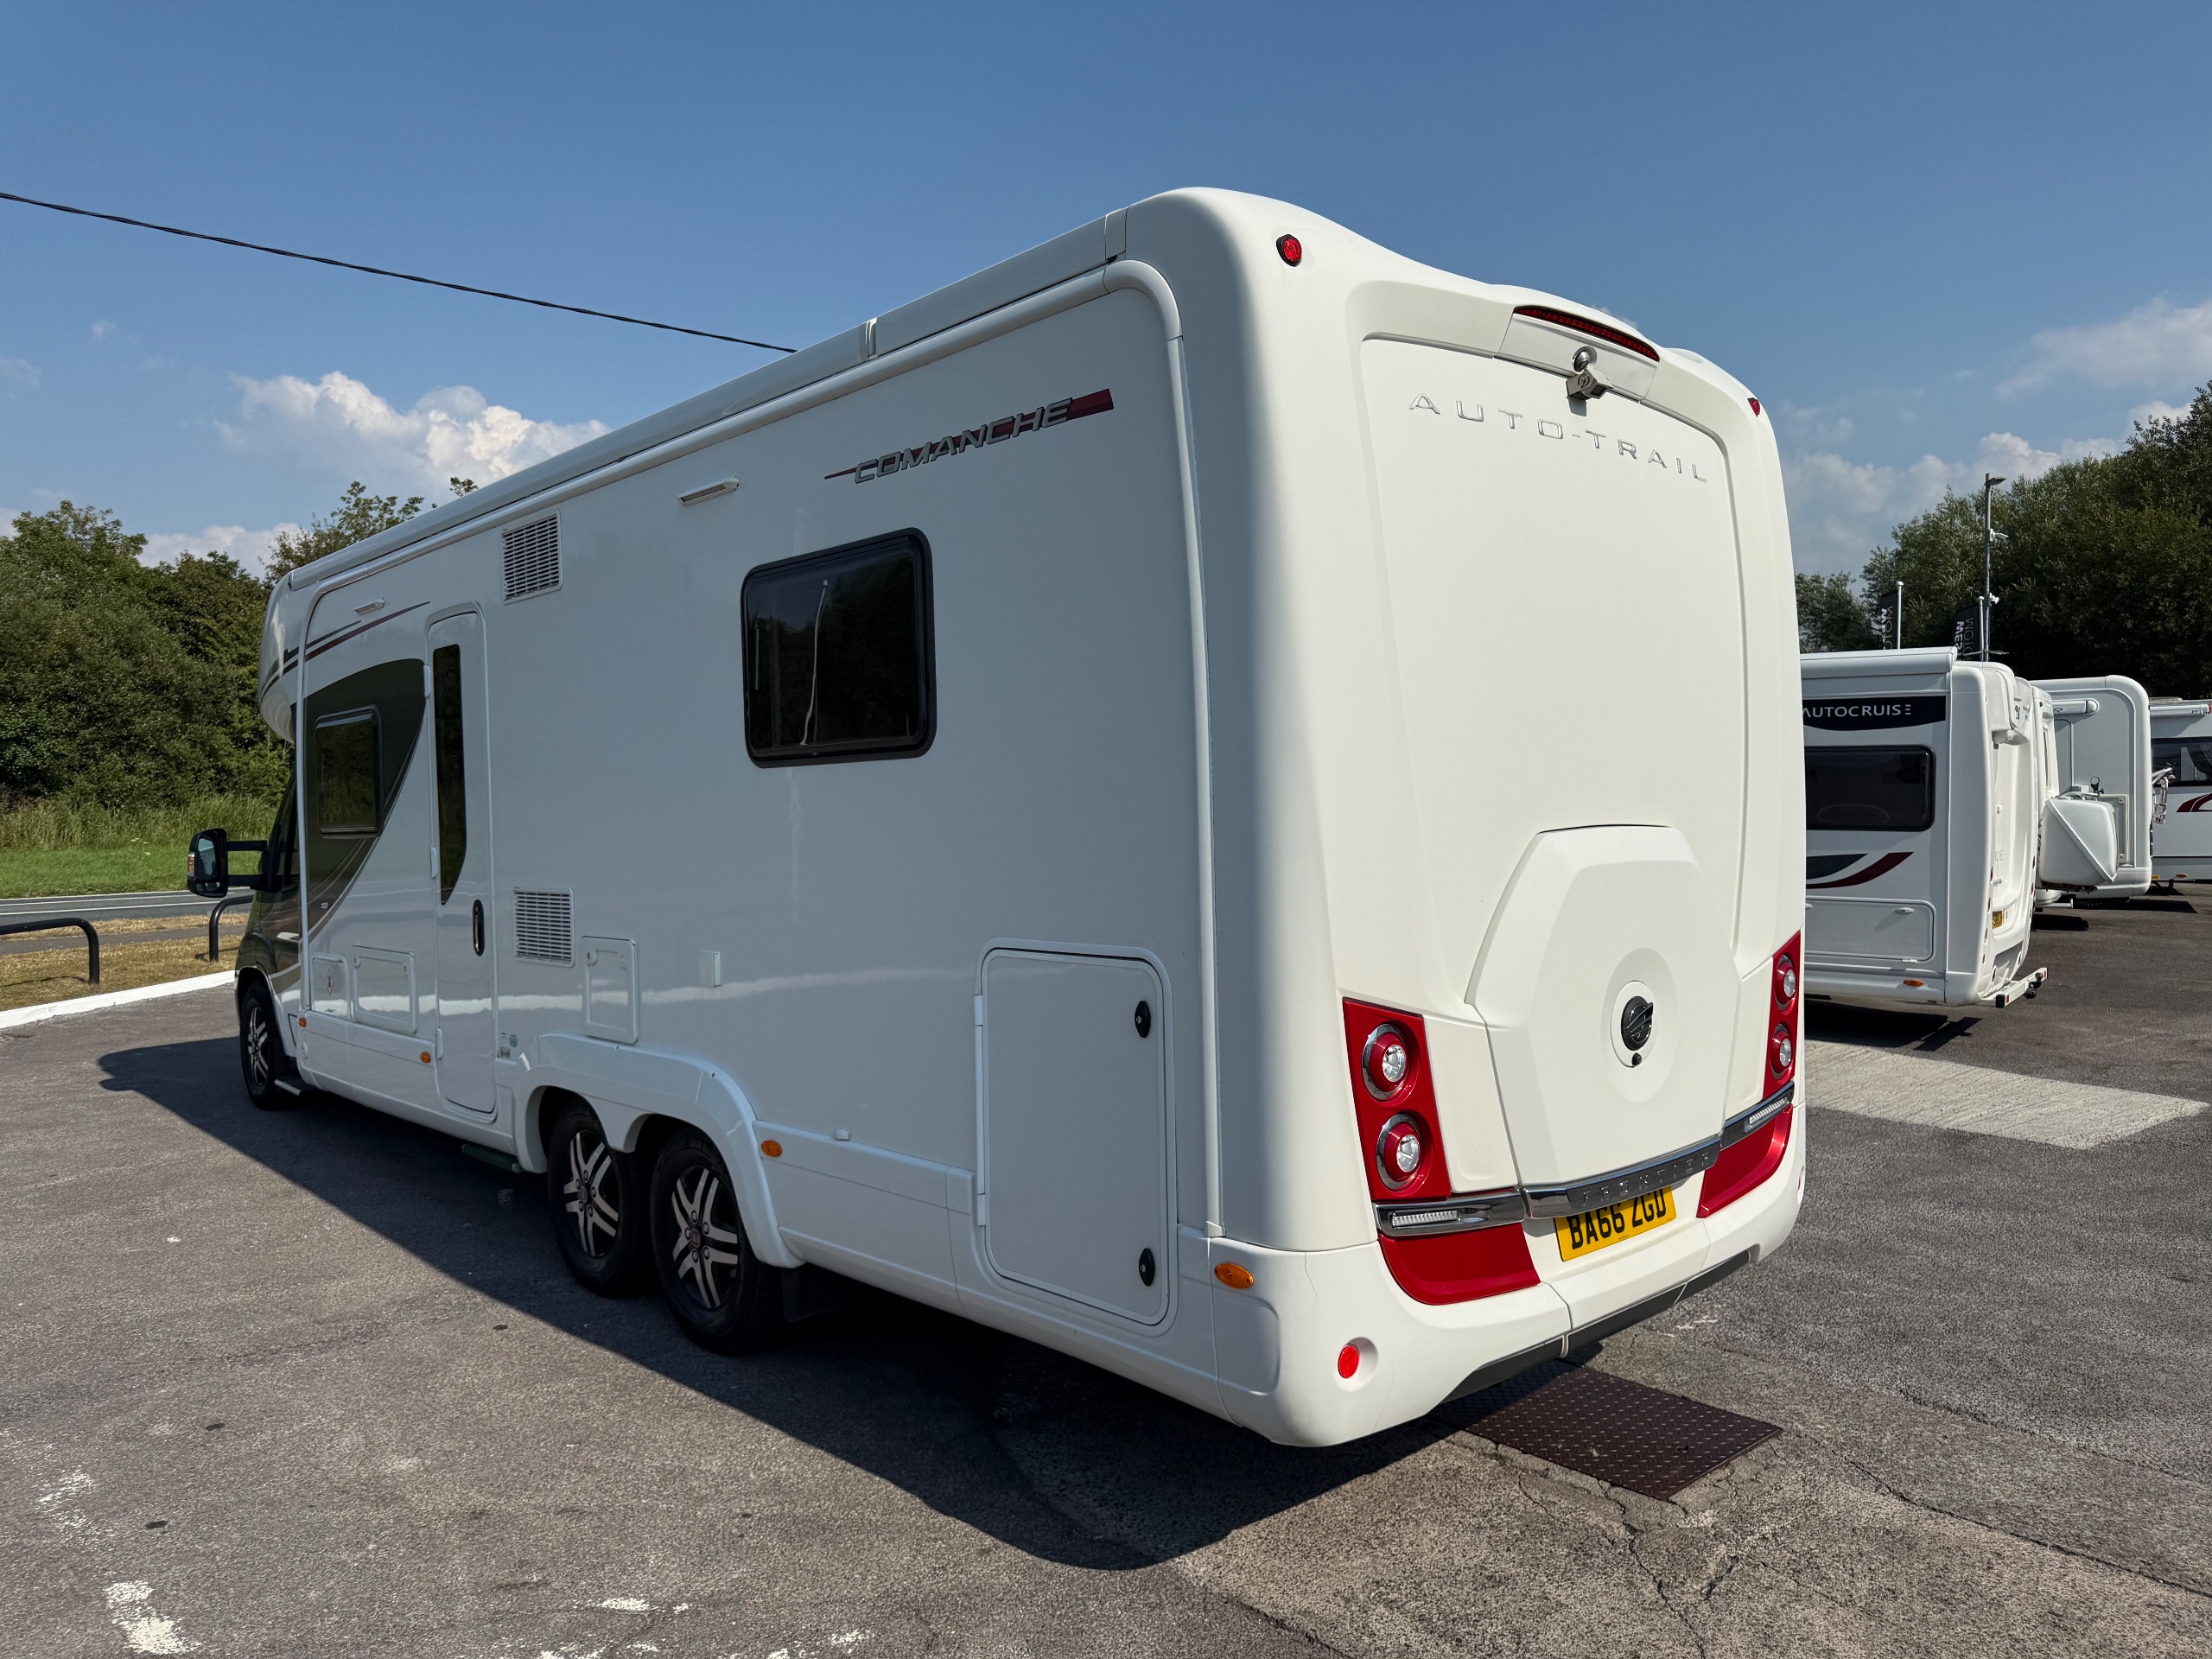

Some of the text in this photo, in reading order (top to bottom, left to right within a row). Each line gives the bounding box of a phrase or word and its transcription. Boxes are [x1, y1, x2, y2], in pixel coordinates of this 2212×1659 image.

[855, 397, 1073, 484] COMANCHE
[1408, 392, 1707, 483] AUTO-TRAIL
[1802, 704, 1911, 718] AUTOCRUISE
[1583, 1153, 1709, 1207] FRONTIER
[1566, 1188, 1667, 1250] BA66 ZGD
